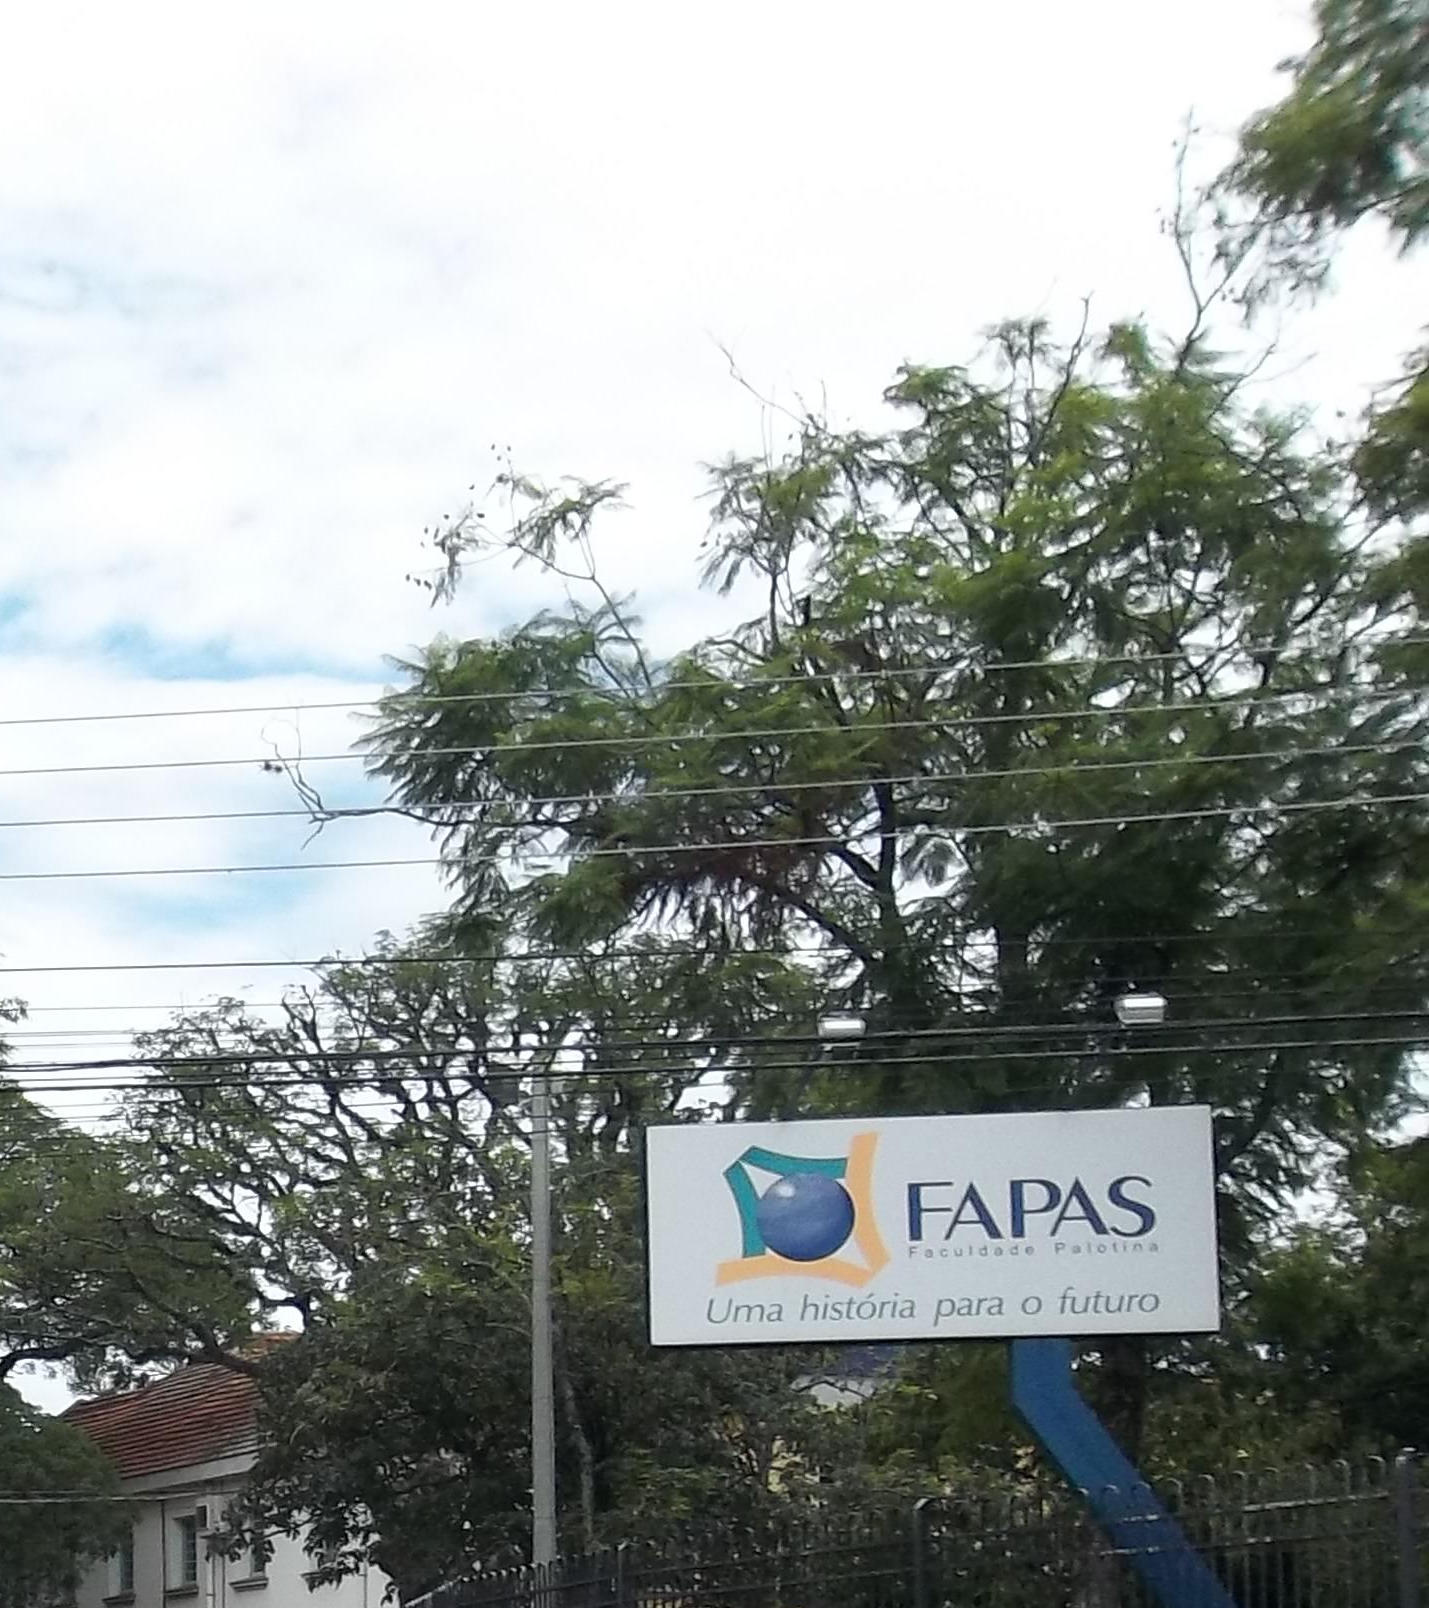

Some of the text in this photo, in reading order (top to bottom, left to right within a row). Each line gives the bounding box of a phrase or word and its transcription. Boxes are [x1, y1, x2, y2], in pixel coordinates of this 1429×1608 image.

[907, 1175, 1157, 1241] FAPAS
[908, 1242, 1160, 1259] Faculdade Palotina
[706, 1286, 1160, 1327] Uma história para o futuro
